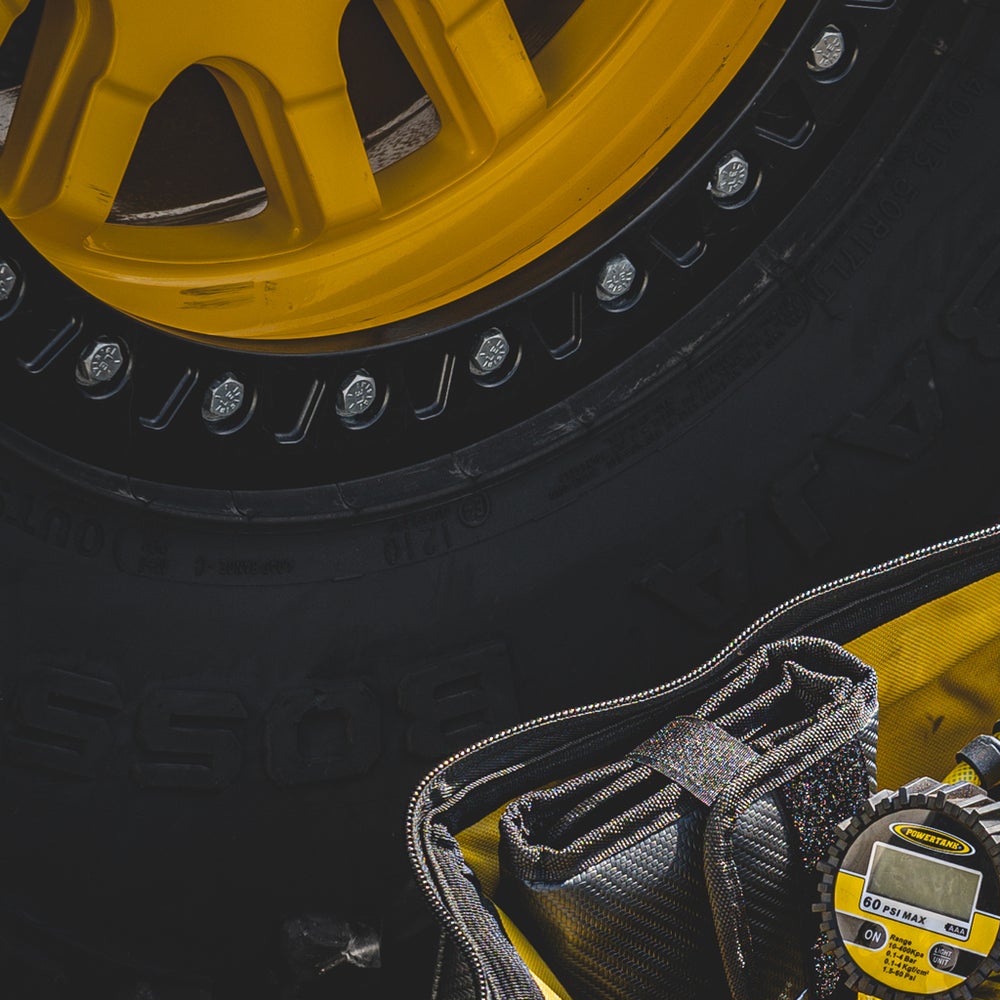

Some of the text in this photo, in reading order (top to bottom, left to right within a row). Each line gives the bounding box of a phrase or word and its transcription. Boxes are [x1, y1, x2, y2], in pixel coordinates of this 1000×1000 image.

[905, 828, 960, 850] POWERTANK
[862, 896, 927, 925] 60 PSI MAX
[864, 928, 882, 943] ON
[948, 924, 967, 936] AAA
[889, 933, 913, 946] Range
[933, 956, 950, 966] UNIT
